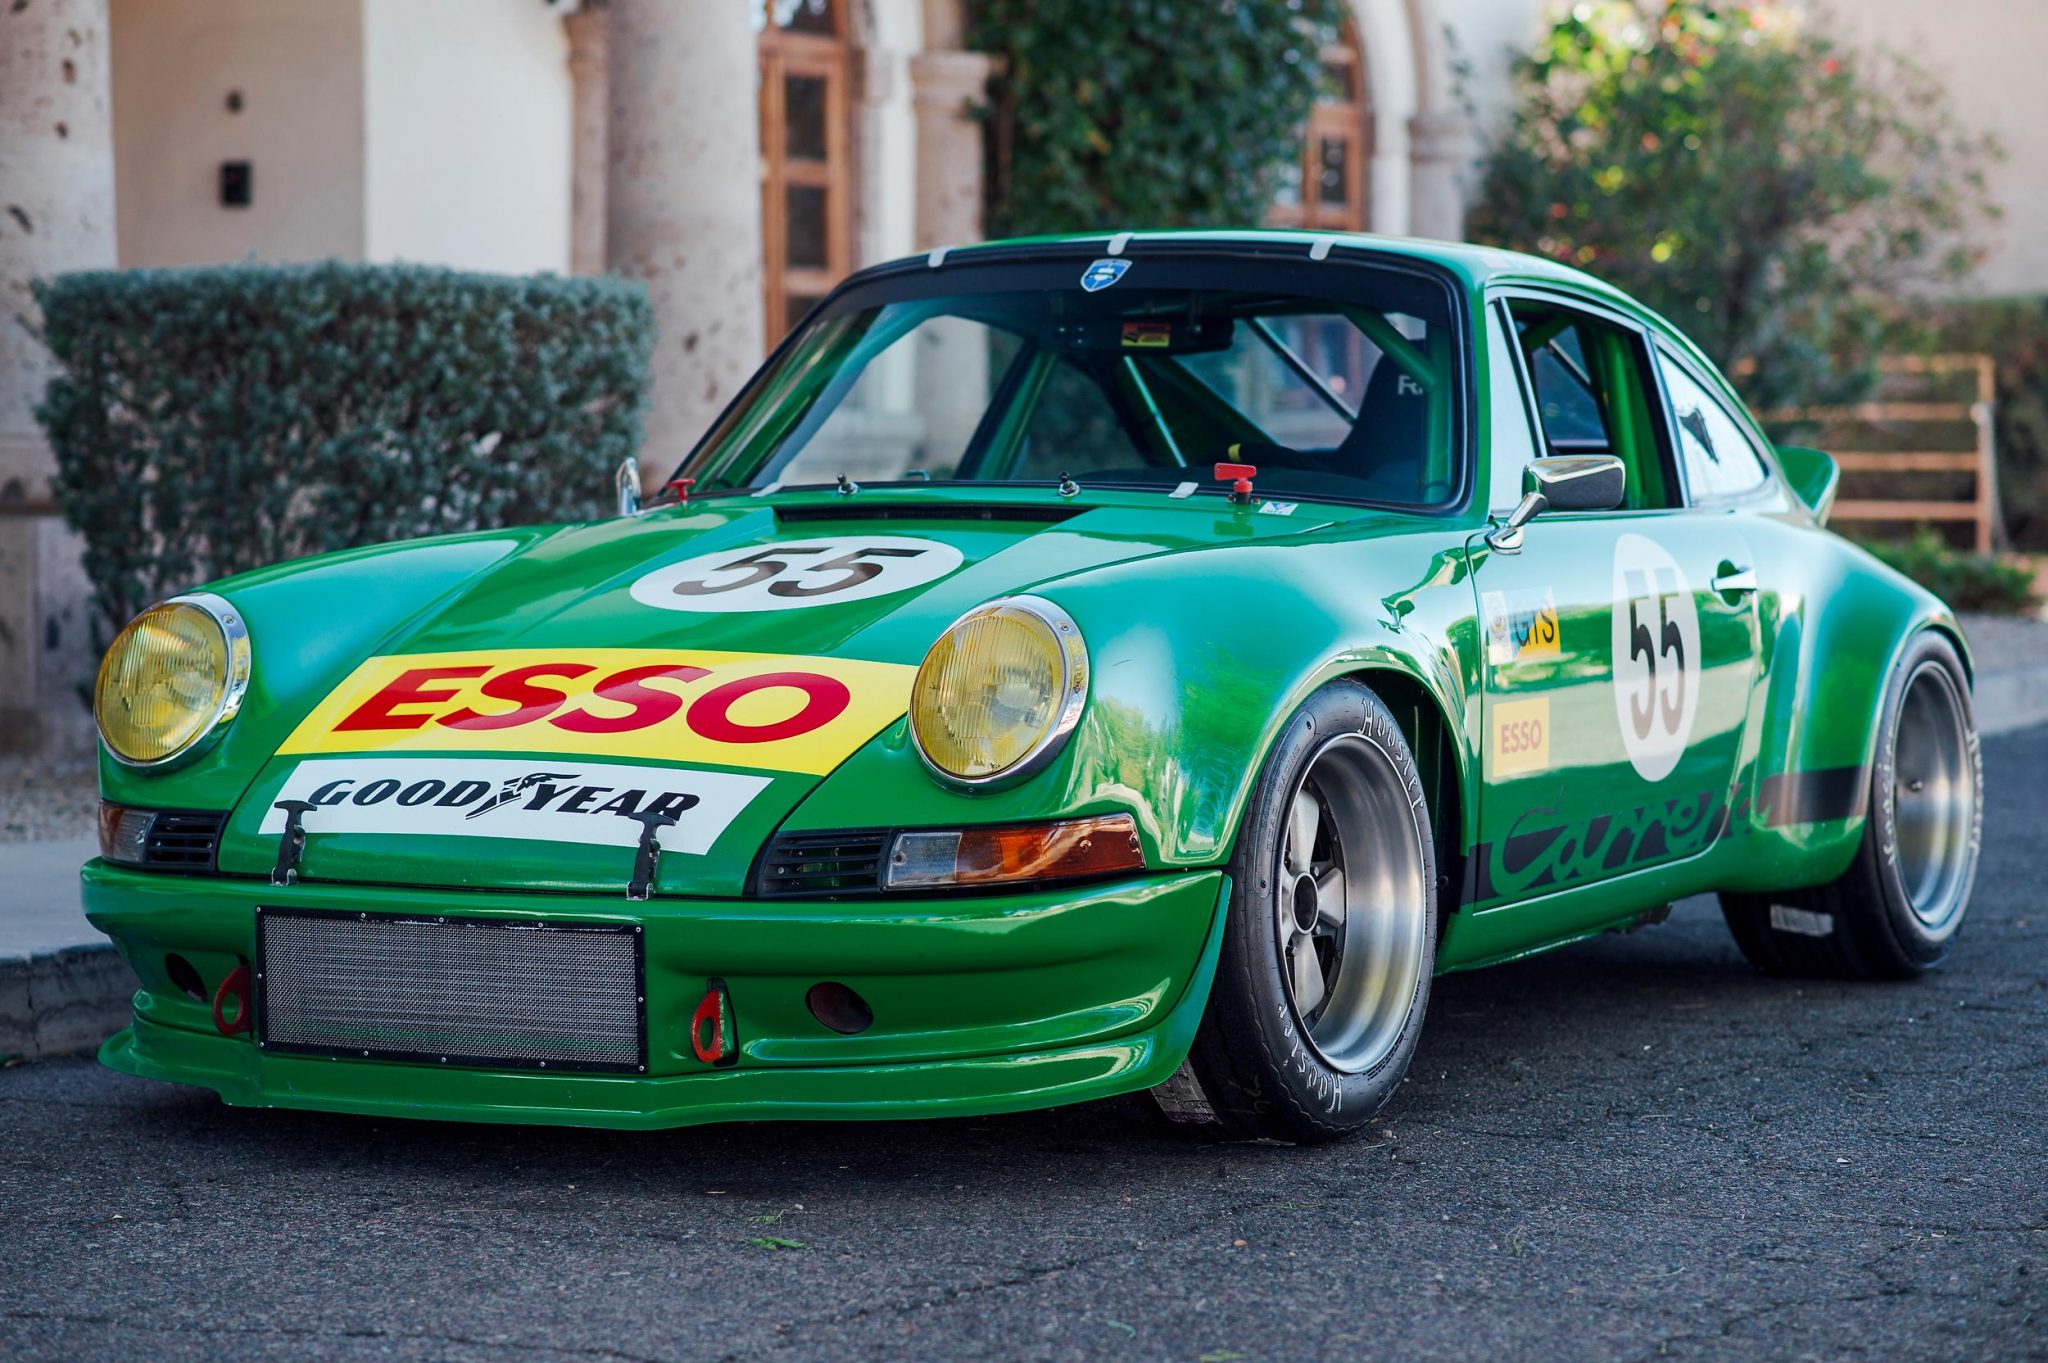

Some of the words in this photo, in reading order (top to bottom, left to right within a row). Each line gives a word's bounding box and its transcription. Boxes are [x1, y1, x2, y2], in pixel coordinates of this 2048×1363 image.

[672, 546, 926, 598] 55
[1624, 566, 1685, 741] 55
[331, 662, 852, 744] ESSO
[1501, 719, 1542, 755] ESSO
[1489, 785, 1762, 897] Carrera
